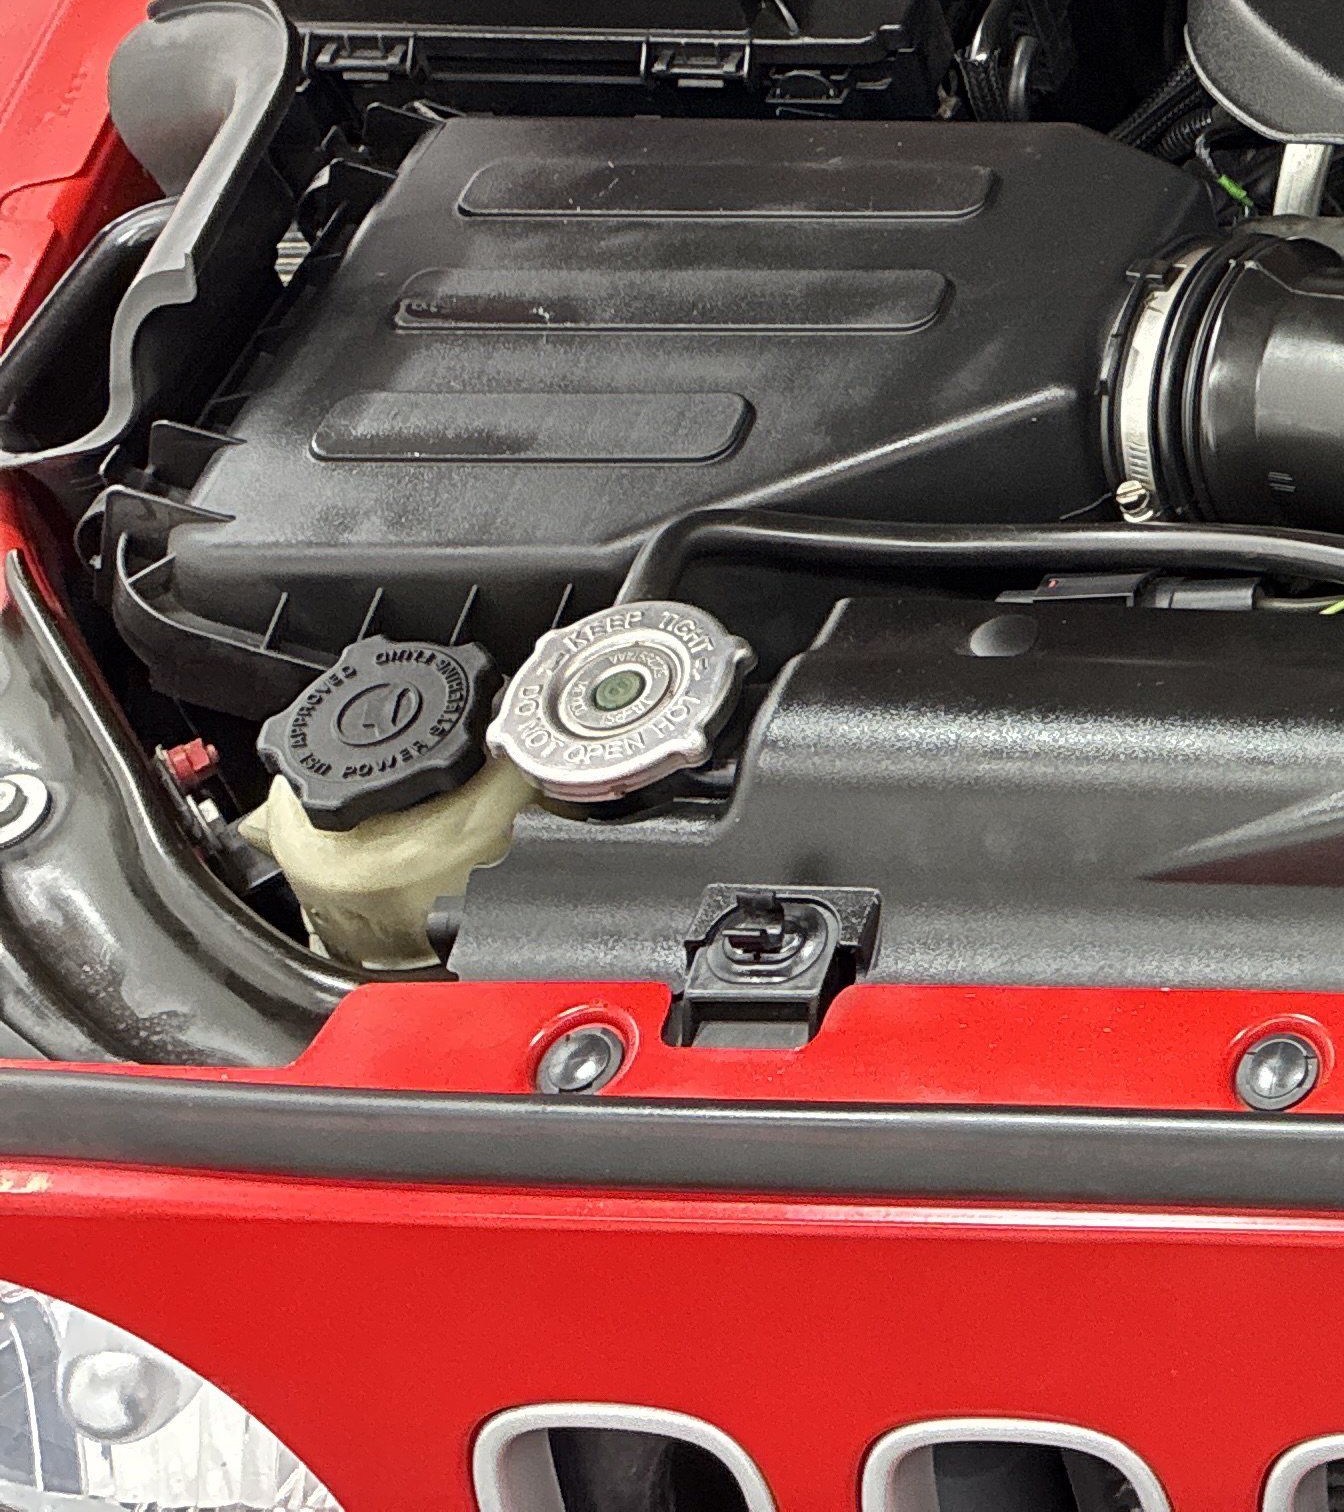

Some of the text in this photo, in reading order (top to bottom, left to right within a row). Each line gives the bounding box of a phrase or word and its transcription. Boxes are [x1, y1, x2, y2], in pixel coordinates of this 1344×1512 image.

[562, 610, 716, 654] KEEP TIGHT
[516, 684, 702, 765] DO NOT OPEN HOT
[341, 739, 430, 780] POWER
